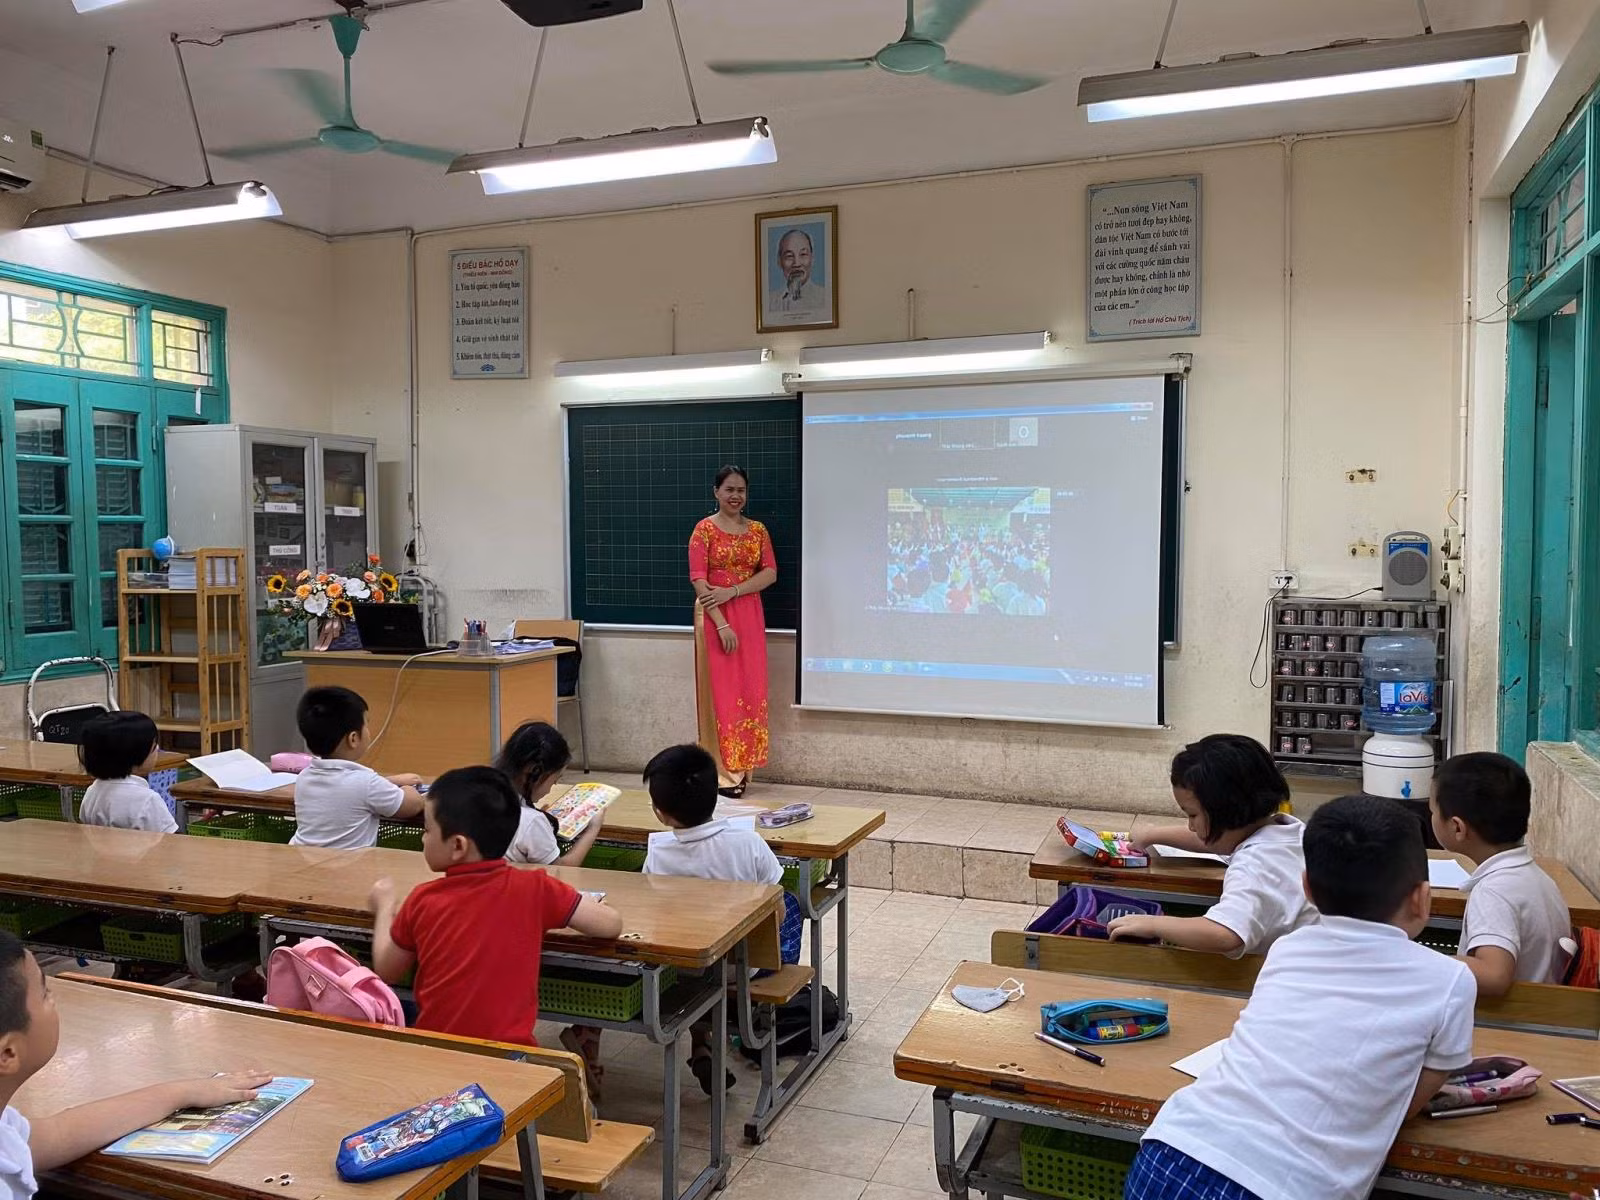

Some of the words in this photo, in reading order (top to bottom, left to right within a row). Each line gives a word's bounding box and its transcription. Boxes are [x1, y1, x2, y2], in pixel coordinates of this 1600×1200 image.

[1152, 202, 1167, 212] Việt
[1170, 200, 1188, 209] Nam
[1095, 222, 1103, 230] có
[1143, 217, 1154, 227] đẹp
[1156, 215, 1168, 225] hay
[1121, 233, 1134, 242] Việt
[1136, 231, 1151, 239] Nam
[1162, 229, 1178, 237] bước
[1095, 249, 1106, 257] đài
[1108, 247, 1123, 256] vinh
[1125, 247, 1147, 256] quang
[1150, 242, 1158, 253] để
[1160, 243, 1177, 251] sánh
[1180, 241, 1190, 249] vai
[479, 259, 492, 268] BÁC
[1095, 262, 1104, 271] với
[1106, 262, 1116, 270] các
[1140, 259, 1155, 269] quốc
[1095, 275, 1111, 284] được
[1112, 274, 1123, 284] hay
[1149, 270, 1167, 279] chính
[1170, 270, 1176, 278] là
[1095, 289, 1107, 299] một
[1164, 284, 1176, 294] học
[1095, 303, 1106, 311] của
[1108, 302, 1118, 310] các
